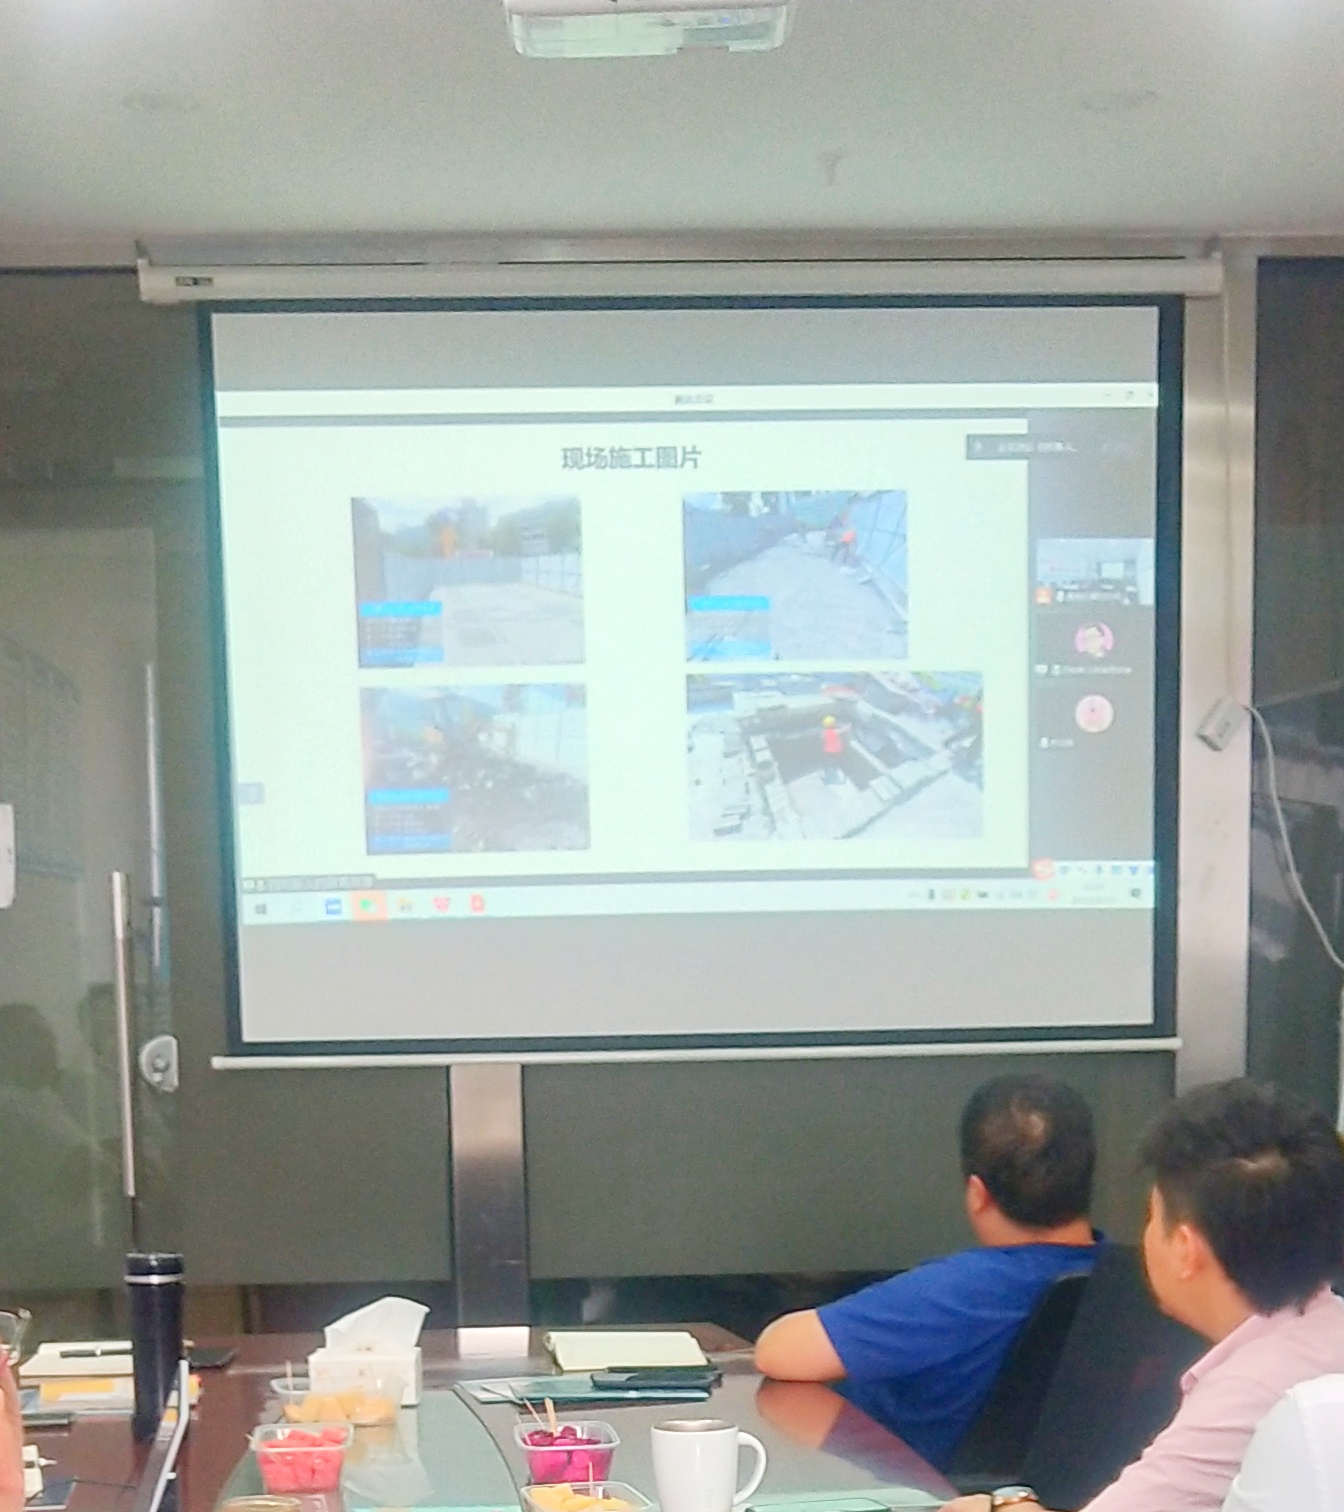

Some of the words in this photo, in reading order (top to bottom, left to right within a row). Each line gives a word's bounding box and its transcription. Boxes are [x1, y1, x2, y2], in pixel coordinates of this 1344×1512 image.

[561, 444, 702, 470] 现场施工图片
